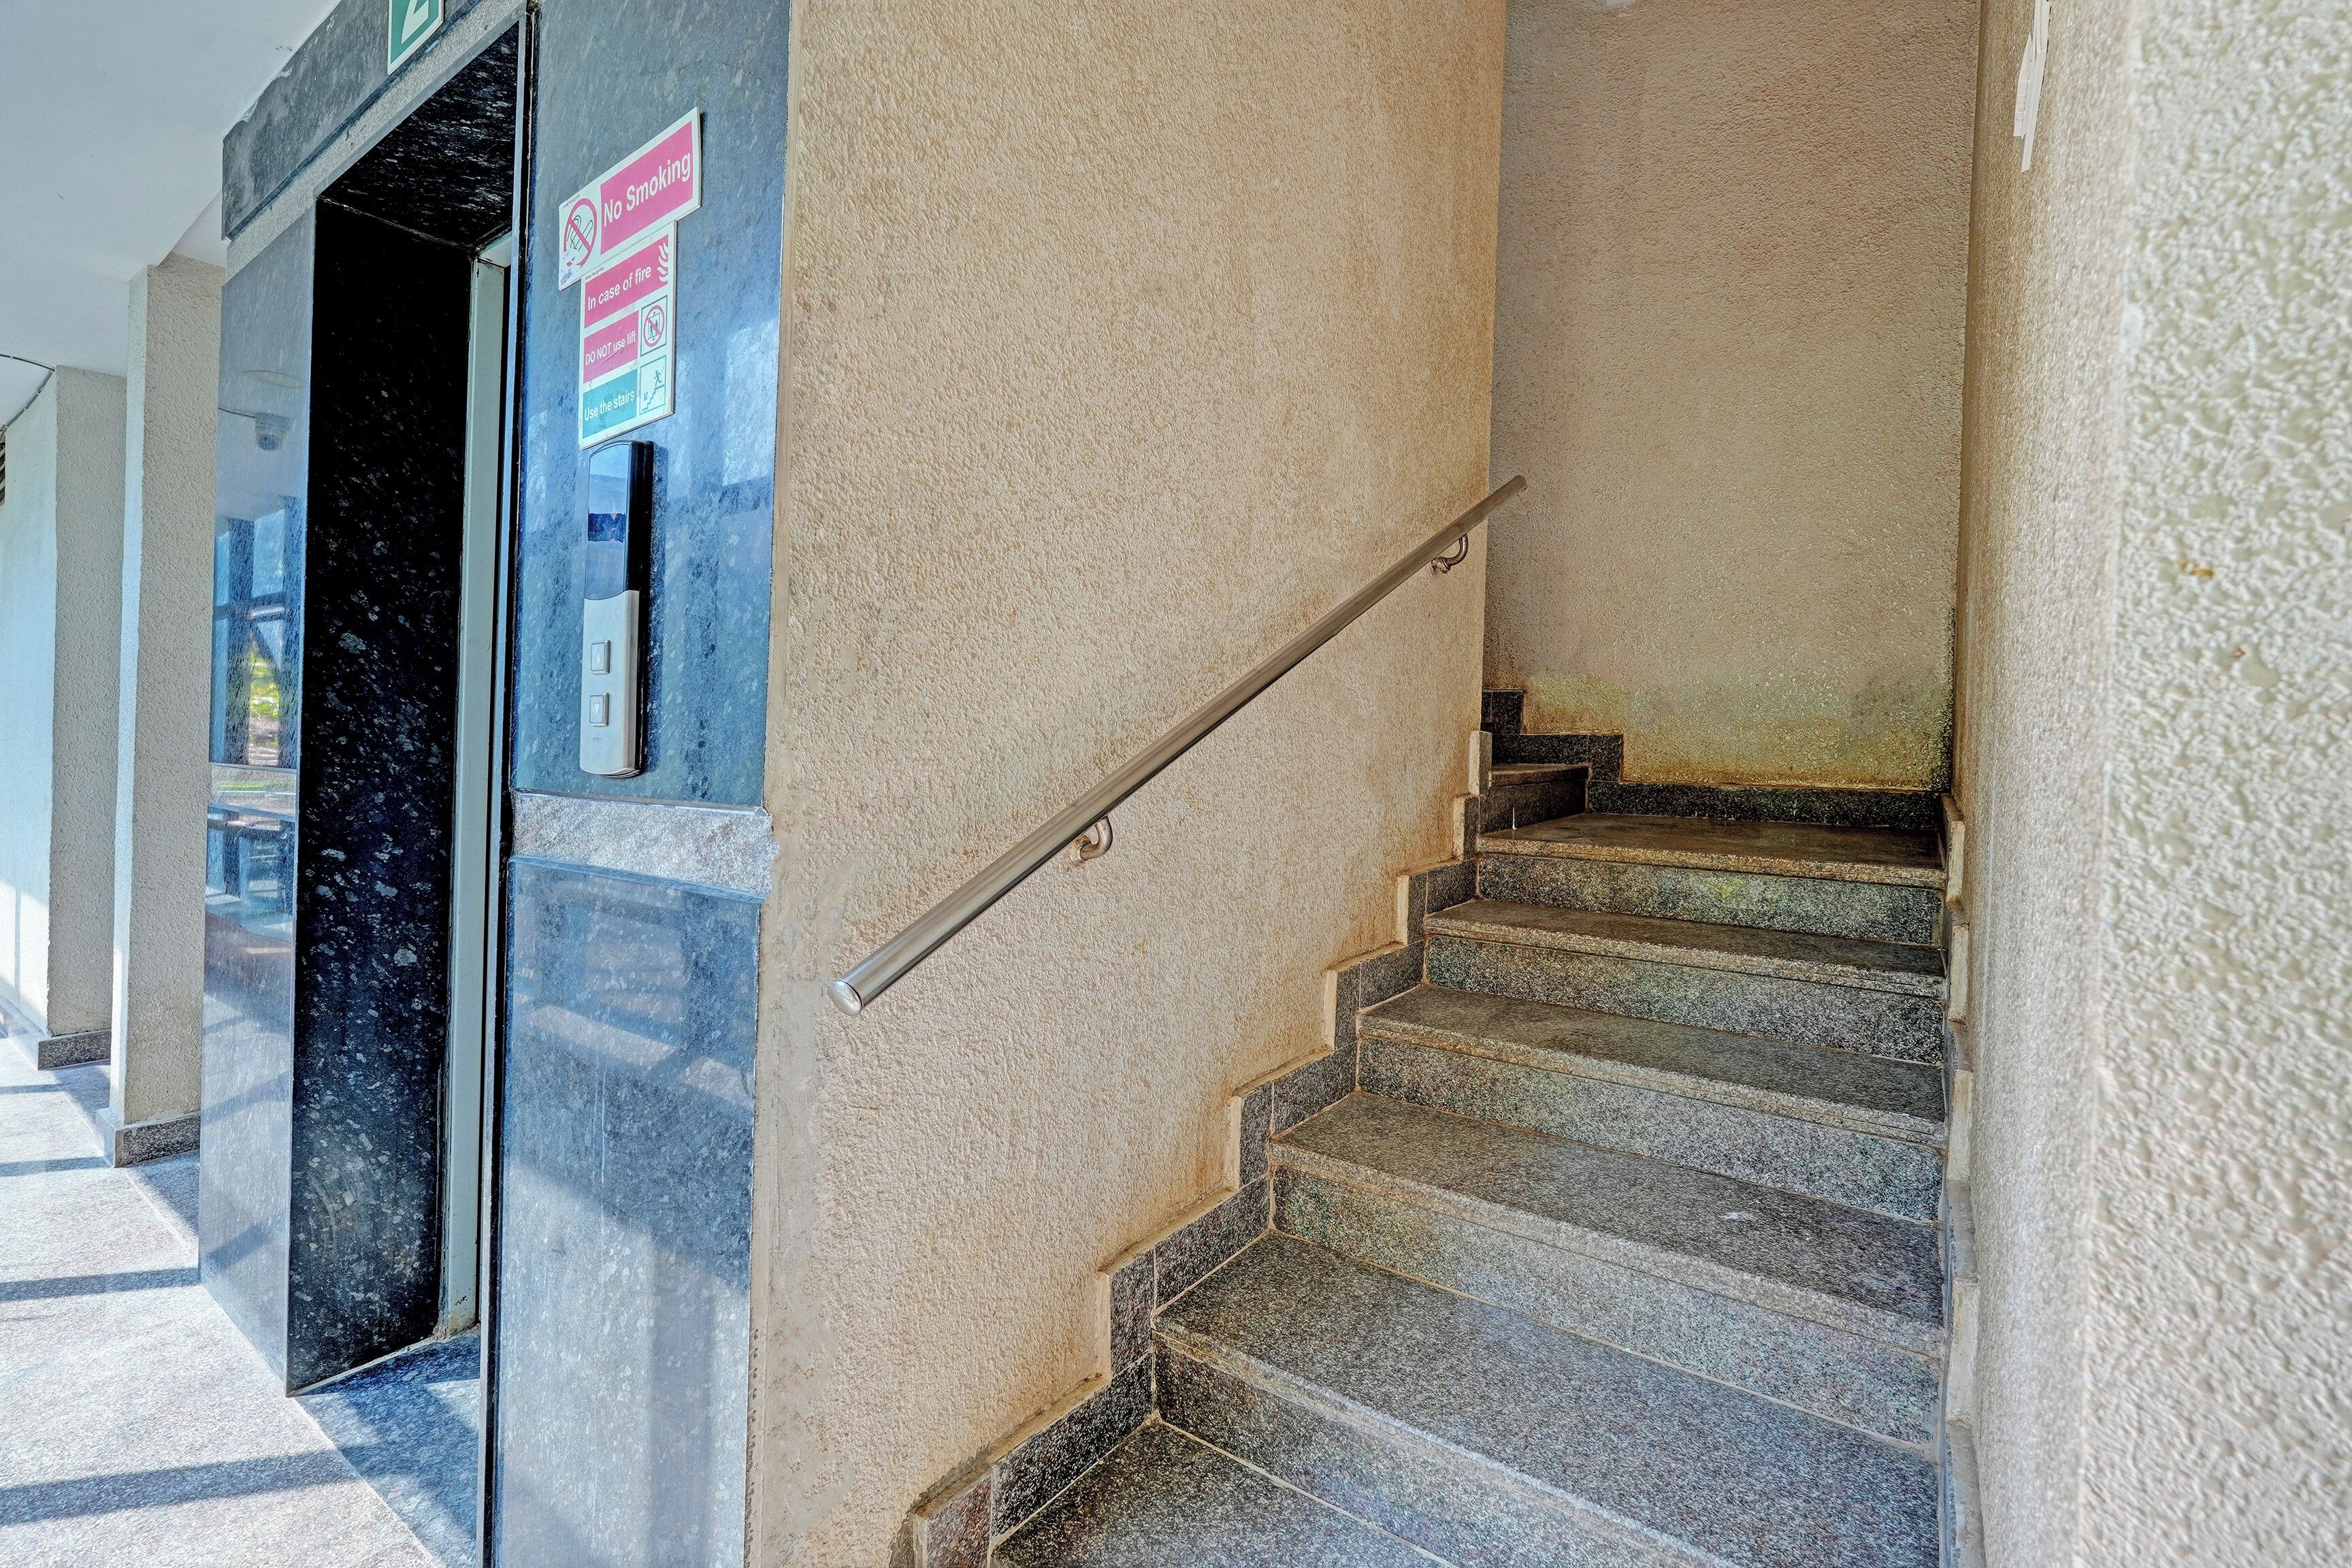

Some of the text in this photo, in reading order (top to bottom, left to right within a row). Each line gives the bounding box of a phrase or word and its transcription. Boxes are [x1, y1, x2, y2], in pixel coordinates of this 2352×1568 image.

[604, 152, 691, 227] No Smoking
[588, 296, 596, 310] In
[598, 284, 621, 304] case
[623, 272, 633, 291] of
[634, 266, 651, 284] fire
[585, 330, 636, 365] DO NOT use lift
[584, 390, 635, 421] Use the stairs
